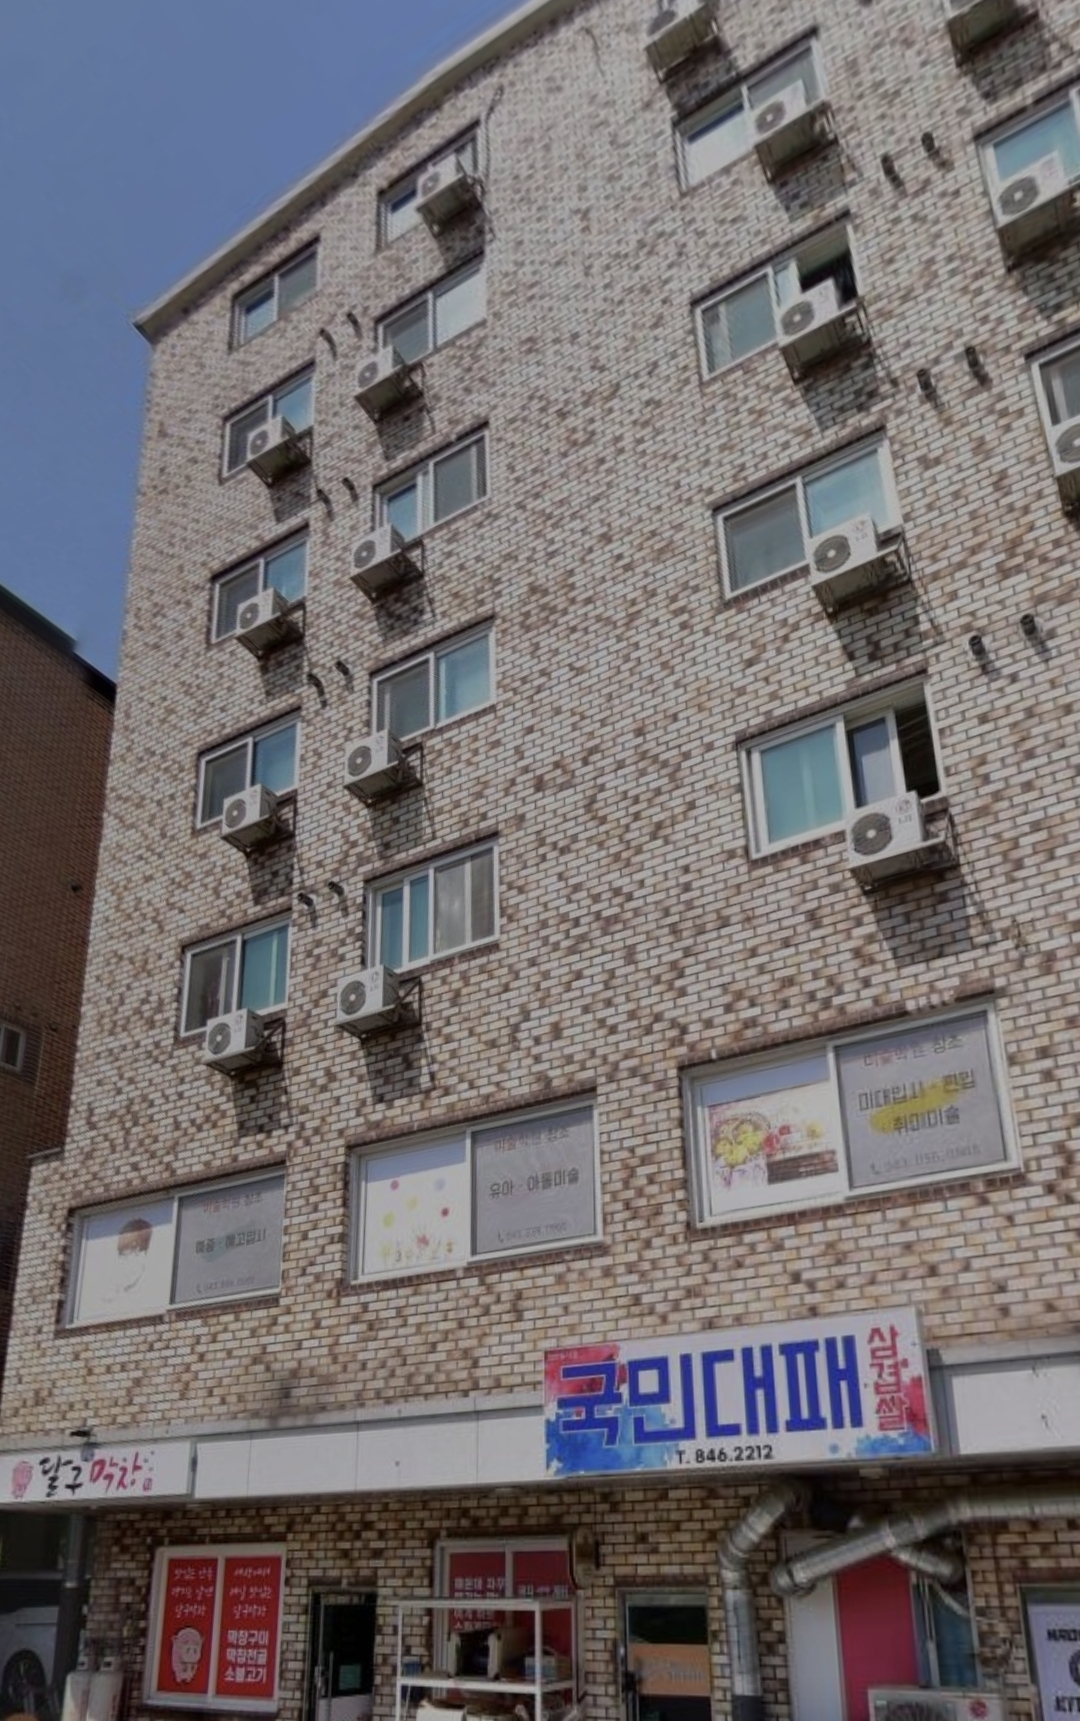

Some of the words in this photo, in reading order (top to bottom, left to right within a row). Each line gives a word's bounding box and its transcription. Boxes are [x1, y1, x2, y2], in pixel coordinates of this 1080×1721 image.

[489, 1179, 514, 1199] 유아
[557, 1334, 864, 1447] 국민대패
[695, 1444, 774, 1464] 846.2212
